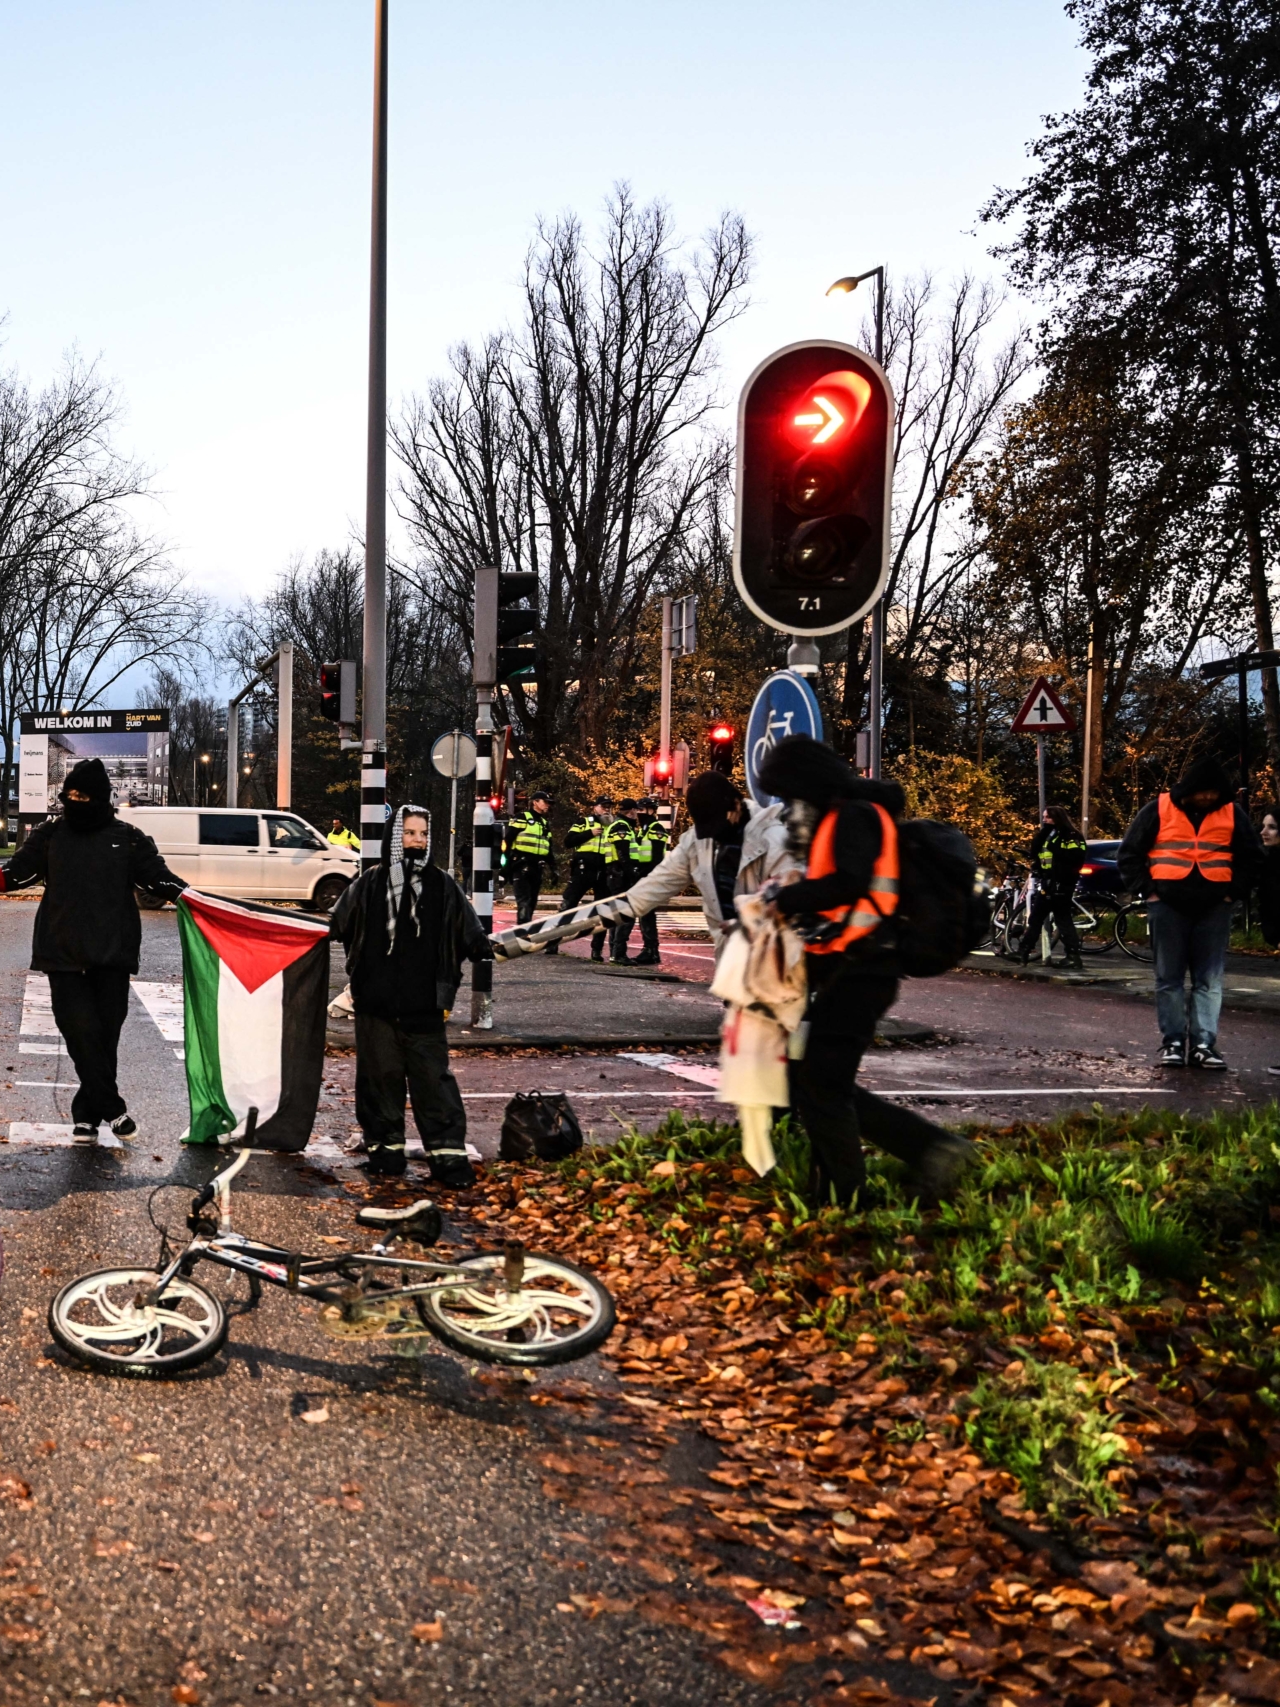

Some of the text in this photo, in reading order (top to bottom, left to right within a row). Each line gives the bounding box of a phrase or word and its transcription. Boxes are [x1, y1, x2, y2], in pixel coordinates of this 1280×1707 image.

[798, 597, 820, 610] 7.1
[34, 716, 112, 729] WELKOM IN
